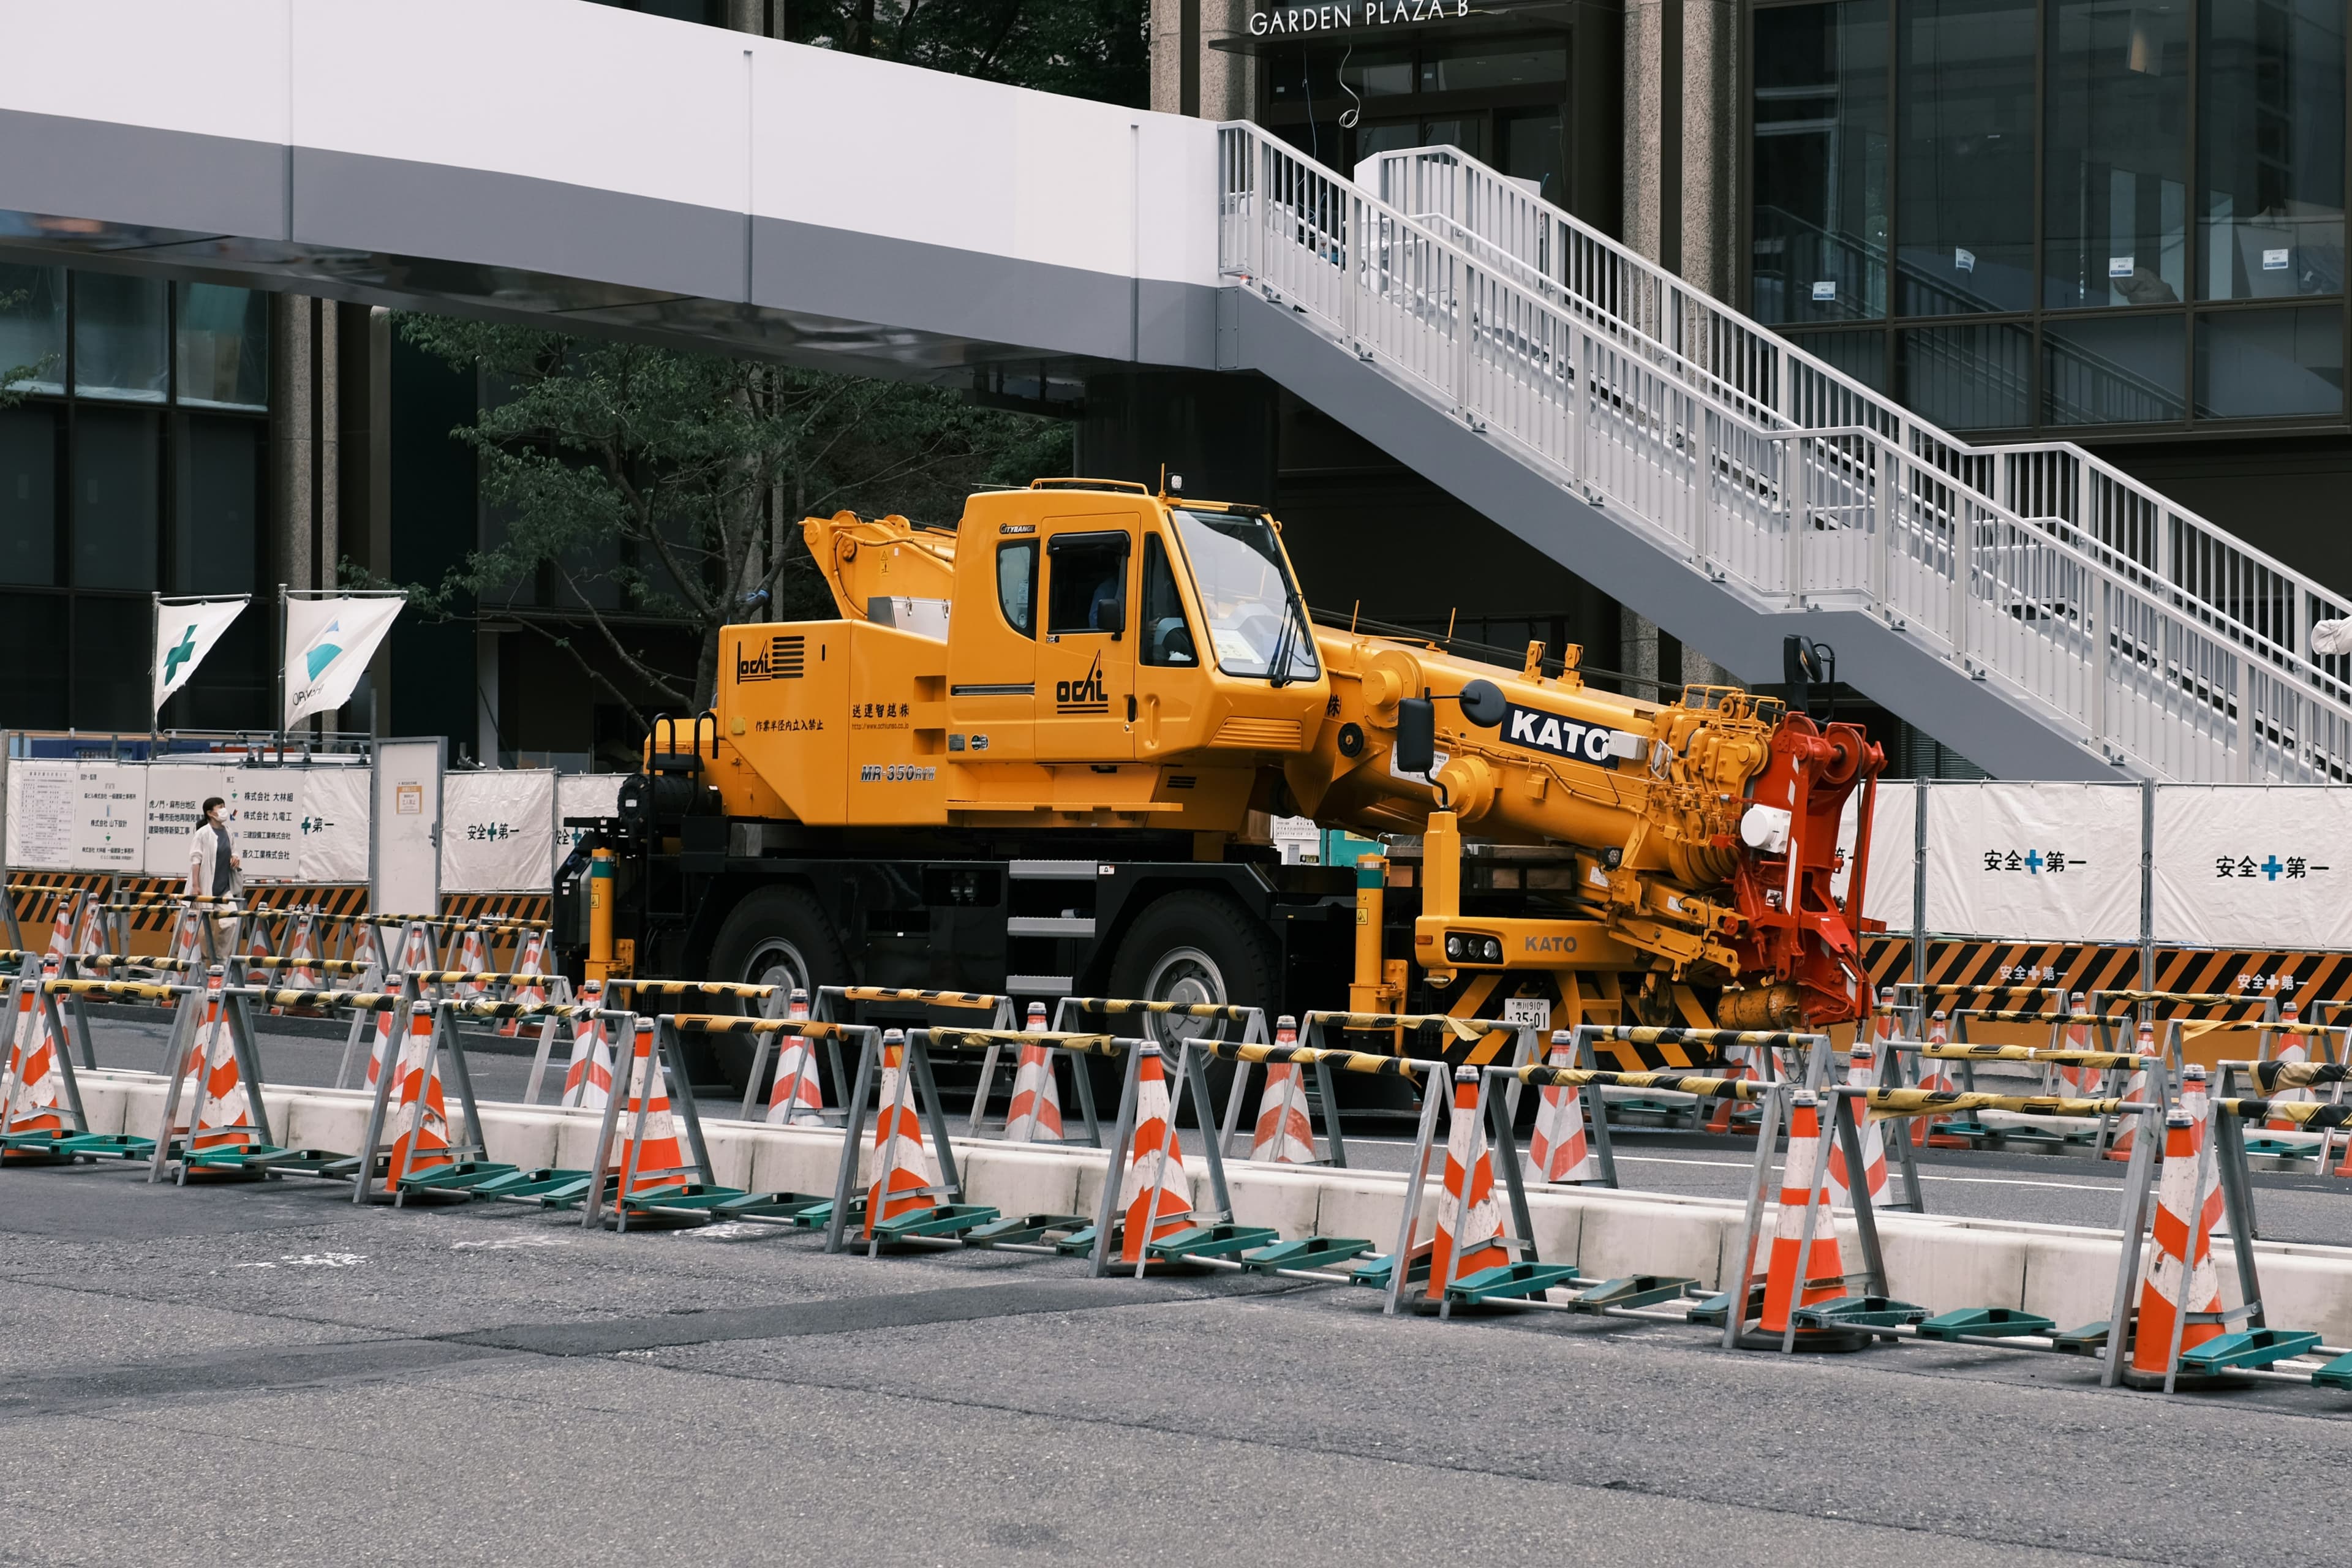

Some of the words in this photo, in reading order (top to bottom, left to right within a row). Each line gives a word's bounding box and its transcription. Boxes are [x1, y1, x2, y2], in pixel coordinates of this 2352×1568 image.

[1250, 4, 1351, 36] GARDEN
[1367, 0, 1444, 25] PLAZA
[1458, 0, 1468, 17] B
[756, 718, 824, 732] 作業半径内立入禁止
[1510, 709, 1610, 761] KATO
[244, 791, 270, 801] 株式会社
[273, 793, 293, 802] 大林組
[244, 811, 269, 821] 株式会社
[272, 812, 292, 821] 九電工
[1525, 936, 1577, 953] KATO
